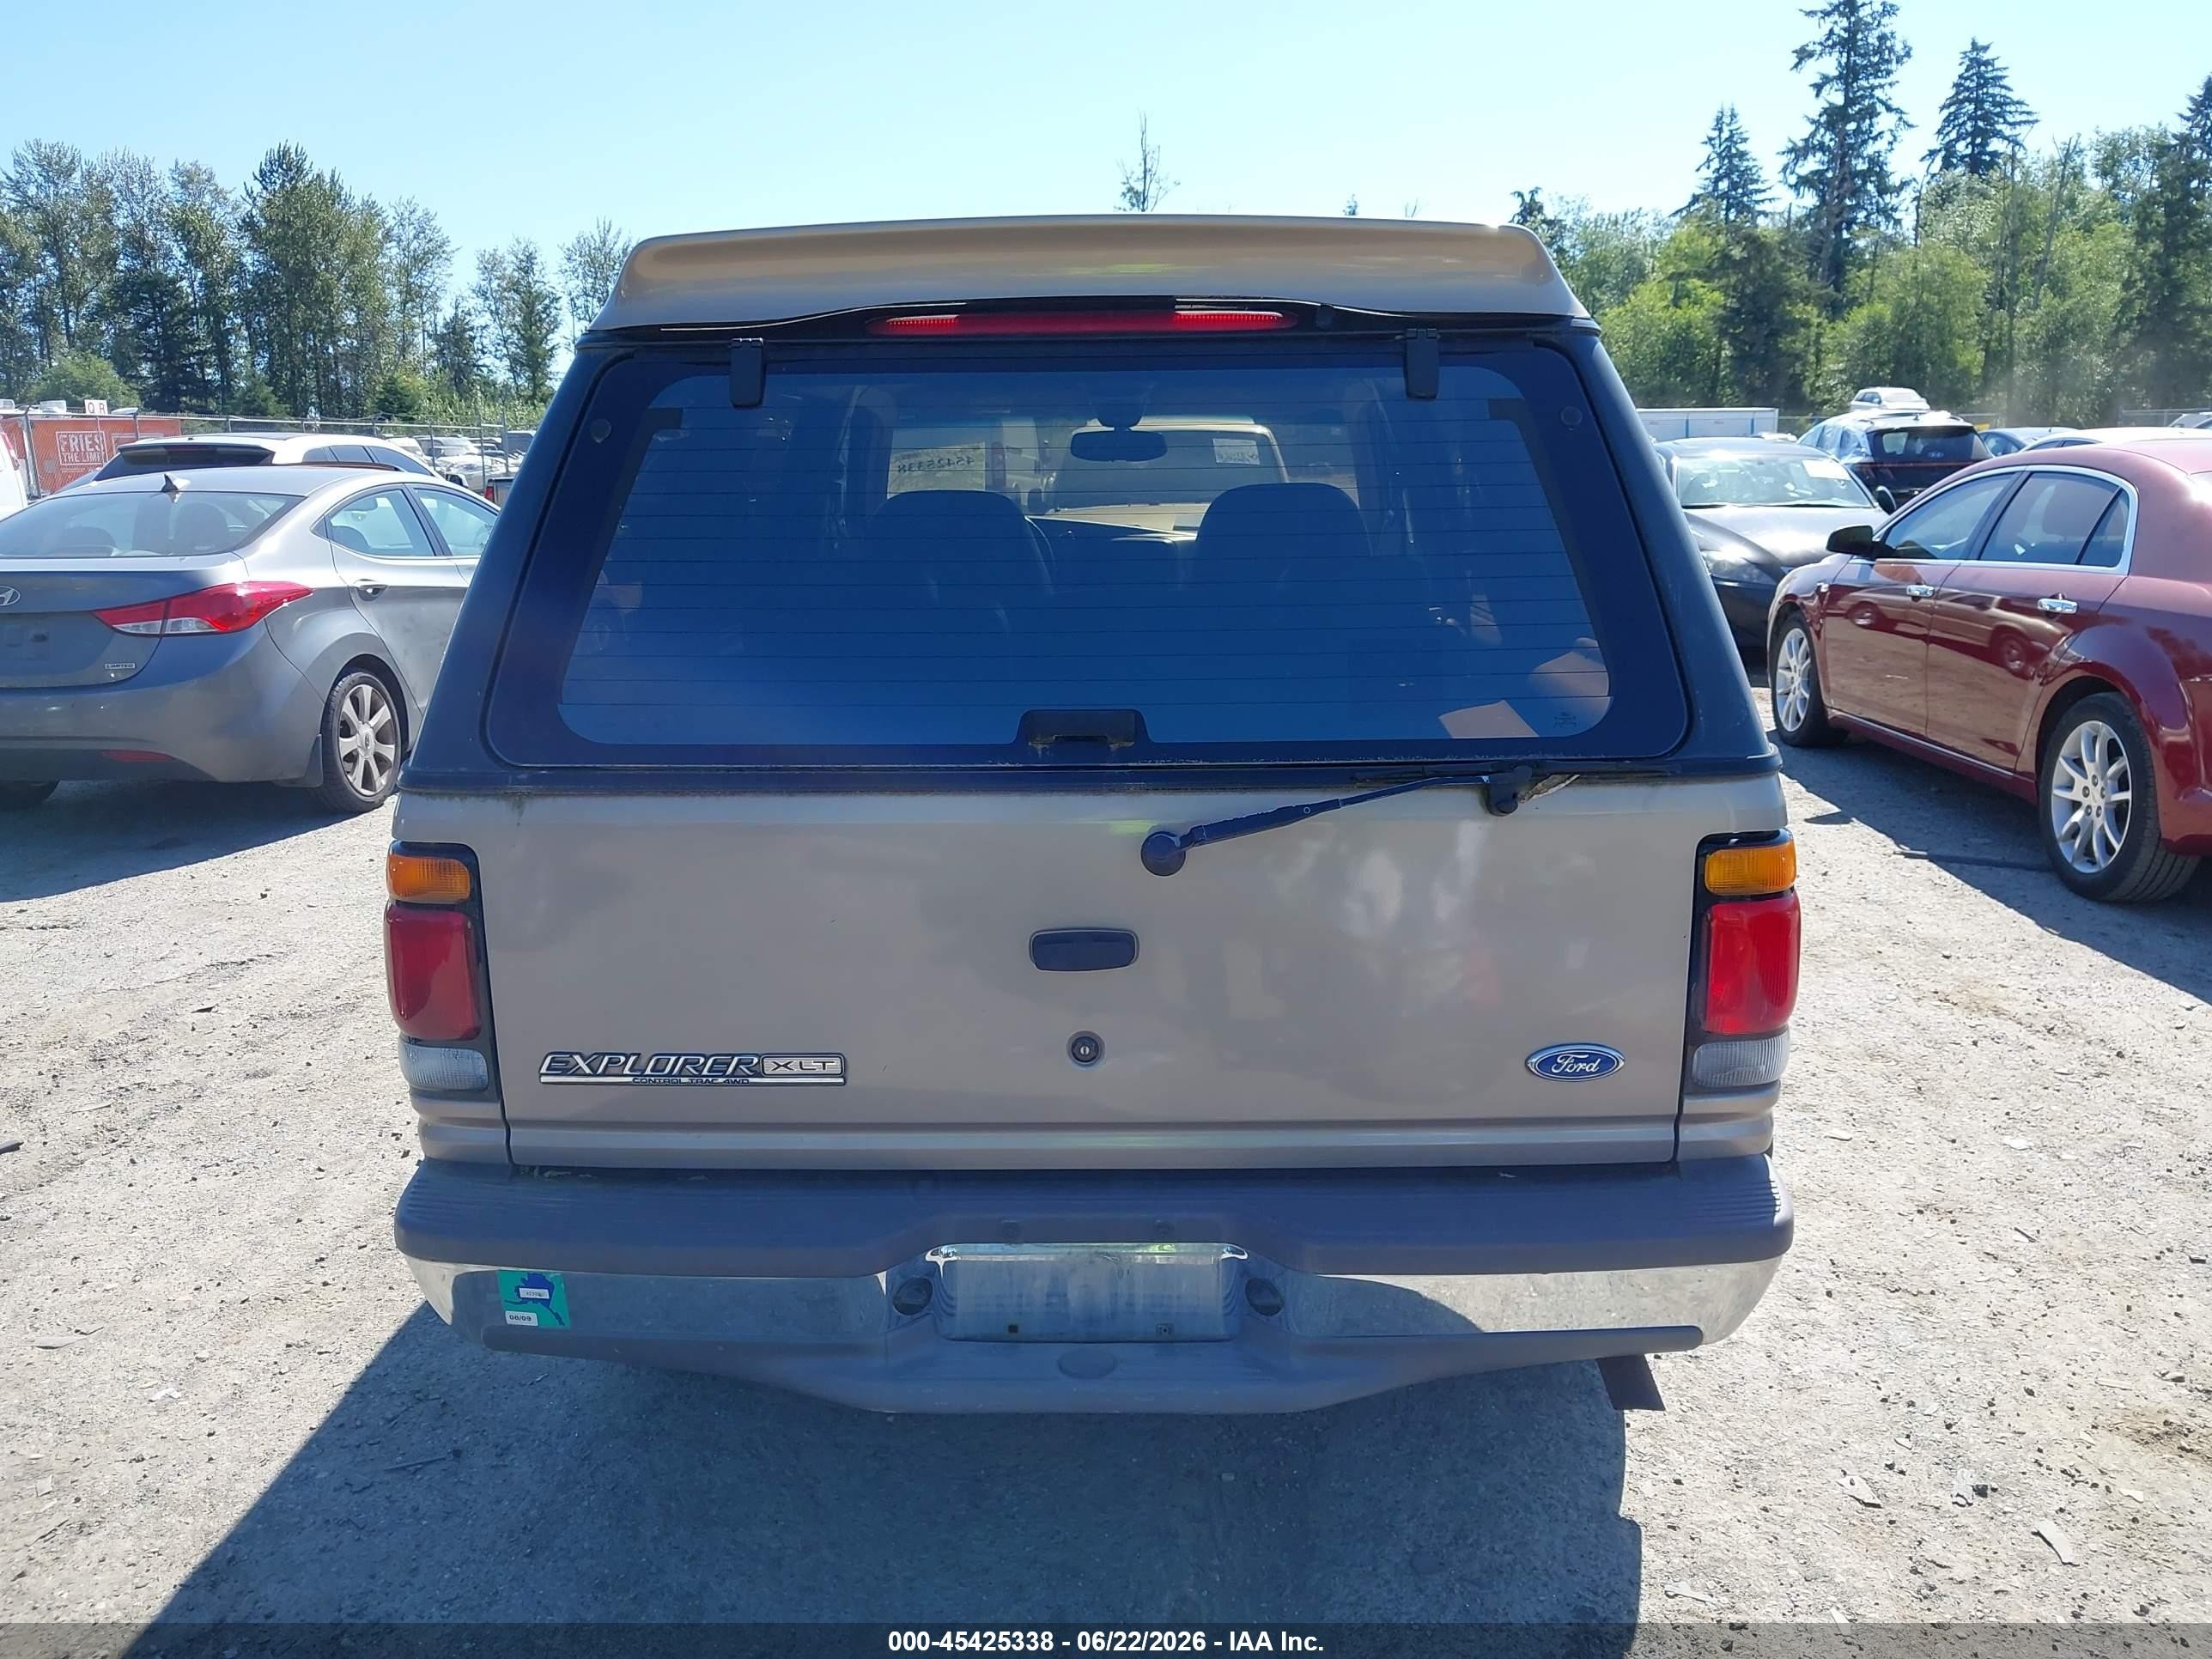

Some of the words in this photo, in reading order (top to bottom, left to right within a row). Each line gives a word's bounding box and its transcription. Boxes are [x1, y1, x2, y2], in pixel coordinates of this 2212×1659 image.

[62, 453, 80, 463] THE
[541, 1053, 760, 1076] EXPLORER
[769, 1060, 837, 1073] XLT
[1551, 1053, 1601, 1073] Ford
